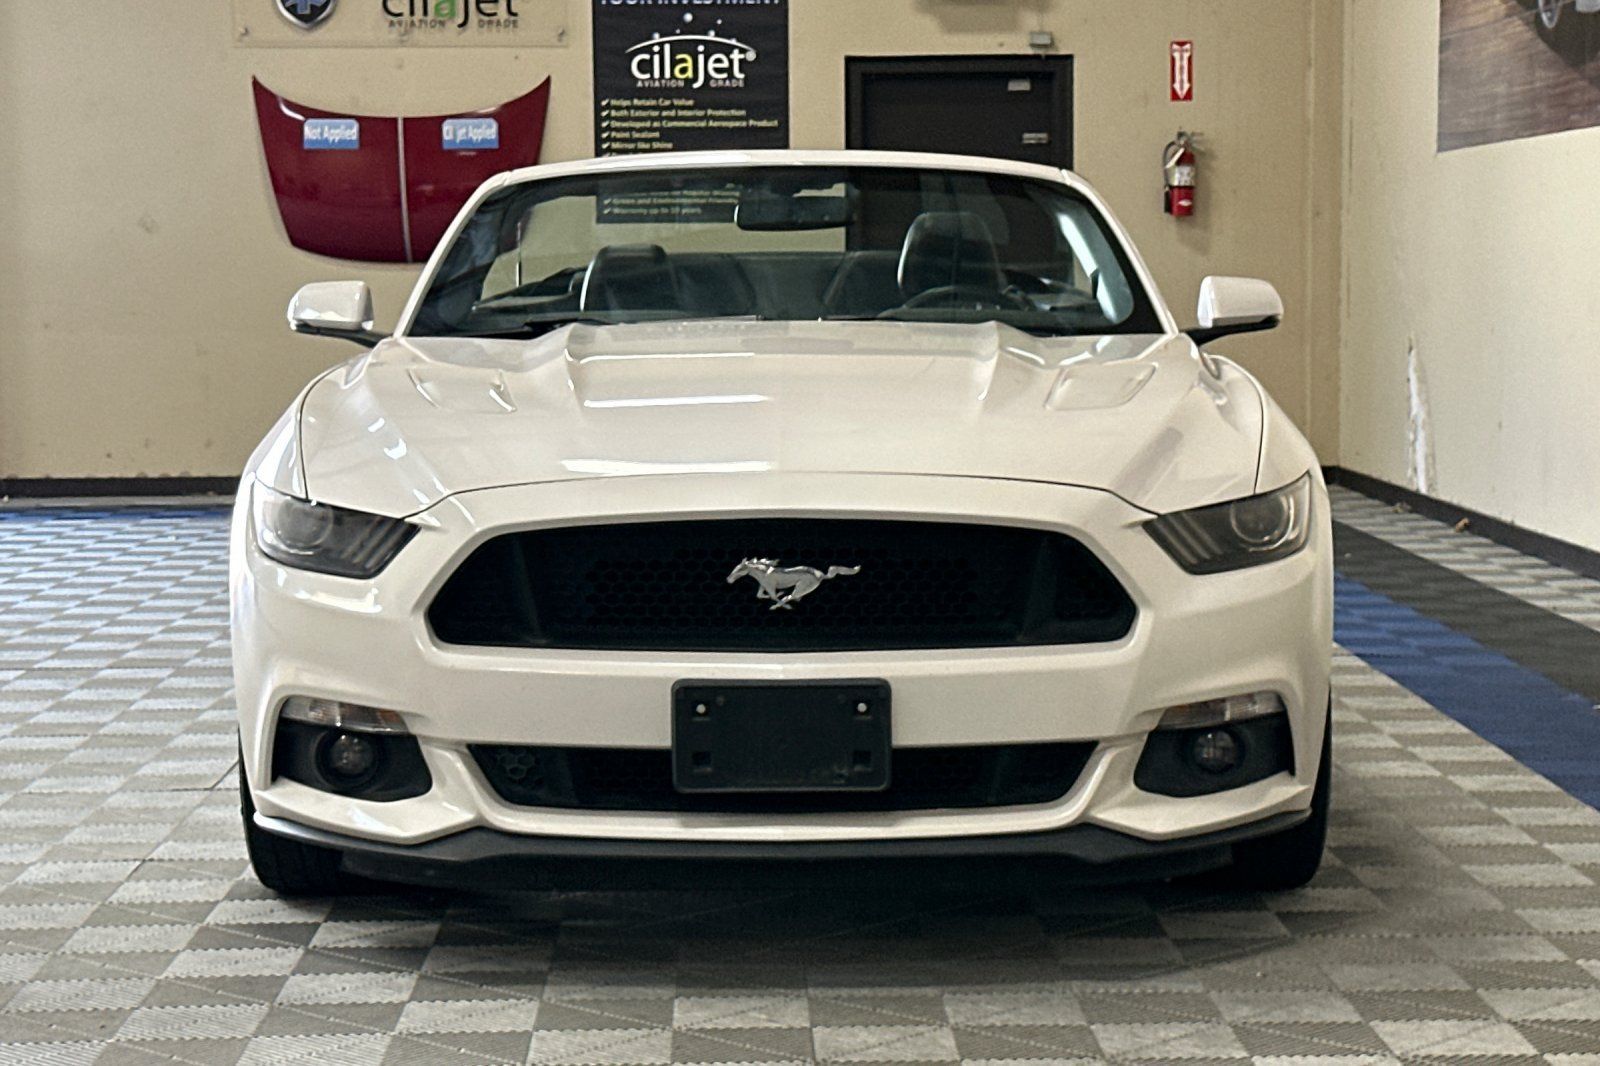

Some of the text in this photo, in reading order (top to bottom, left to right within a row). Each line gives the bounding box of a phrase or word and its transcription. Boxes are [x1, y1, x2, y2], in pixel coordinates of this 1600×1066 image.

[630, 43, 746, 89] cilajet
[636, 79, 745, 88] AVIATION GRADE
